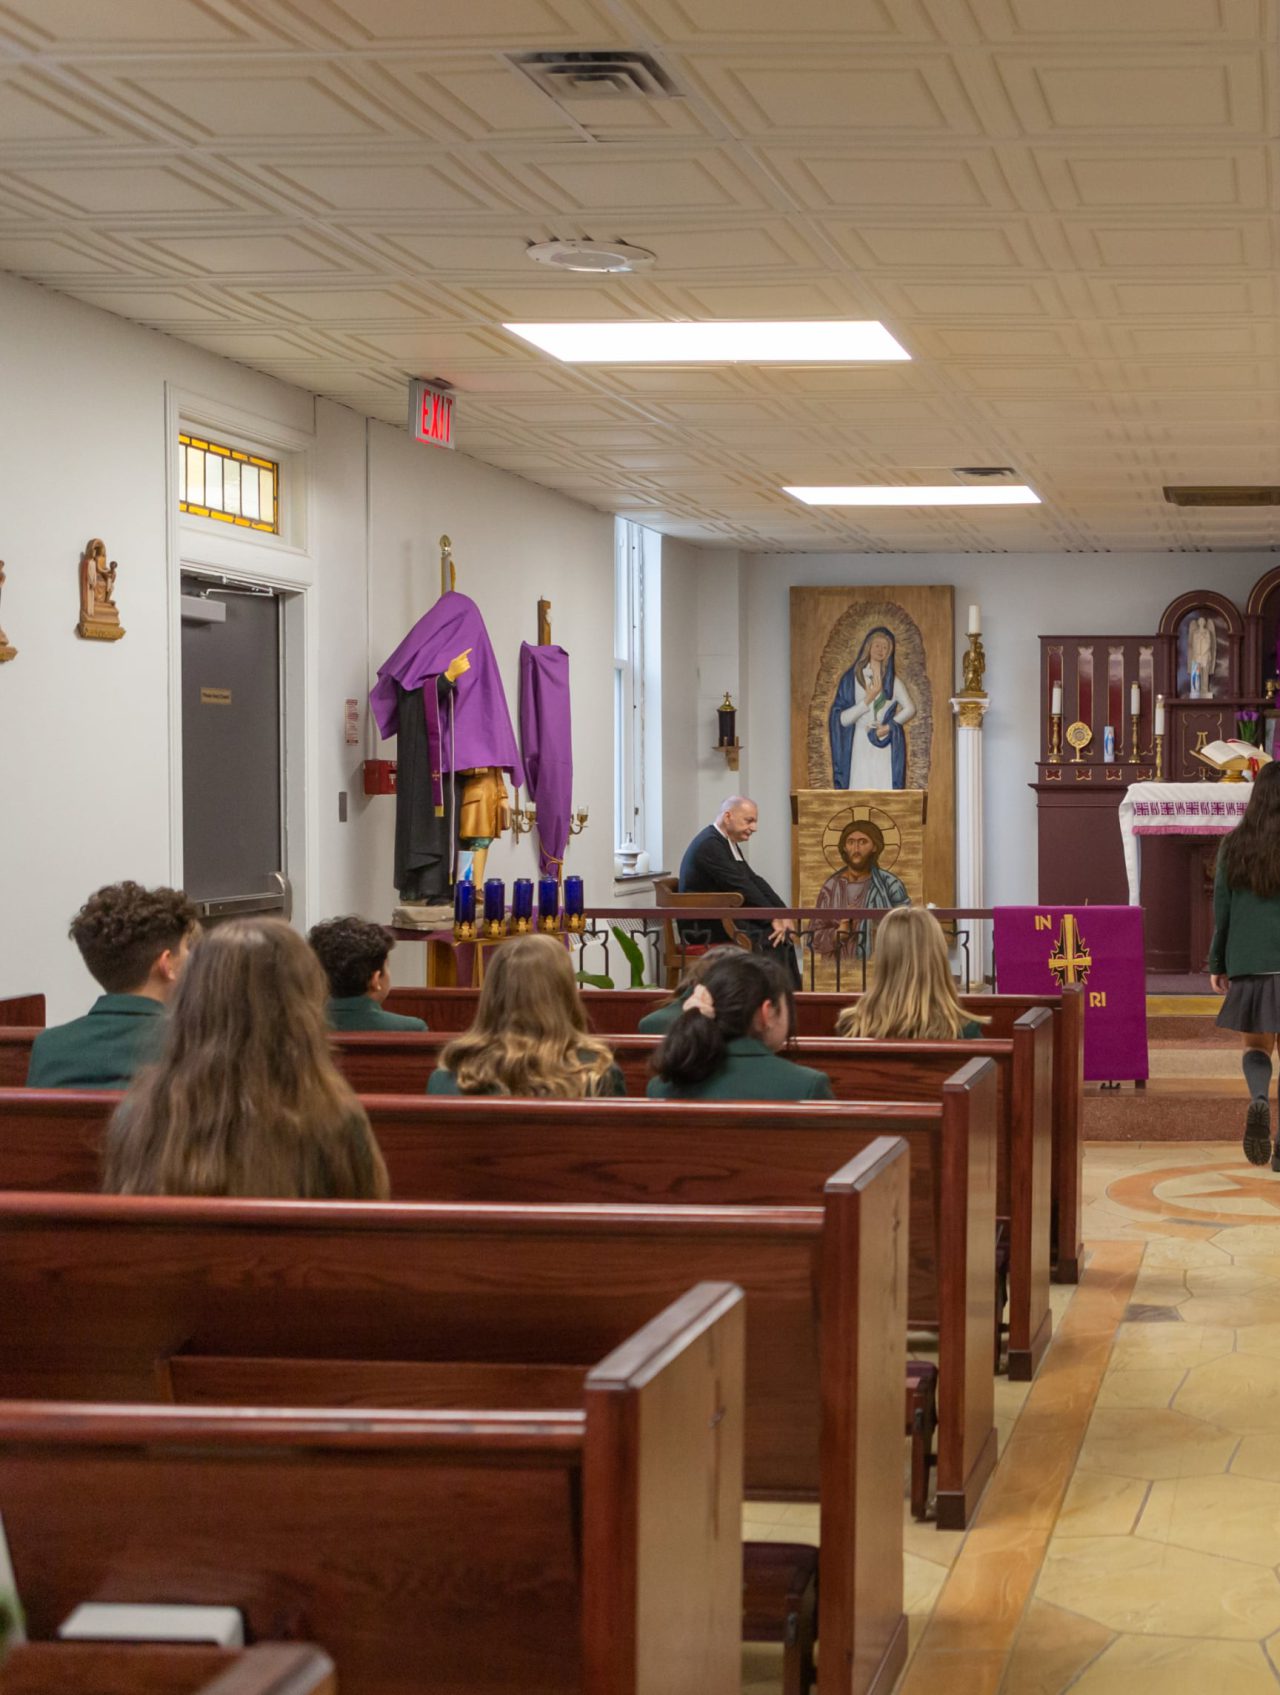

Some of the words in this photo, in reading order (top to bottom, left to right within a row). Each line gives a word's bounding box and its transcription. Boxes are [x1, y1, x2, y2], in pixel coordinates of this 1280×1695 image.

[422, 388, 453, 443] EXIT
[1034, 914, 1052, 931] IN
[1089, 991, 1106, 1008] RI
